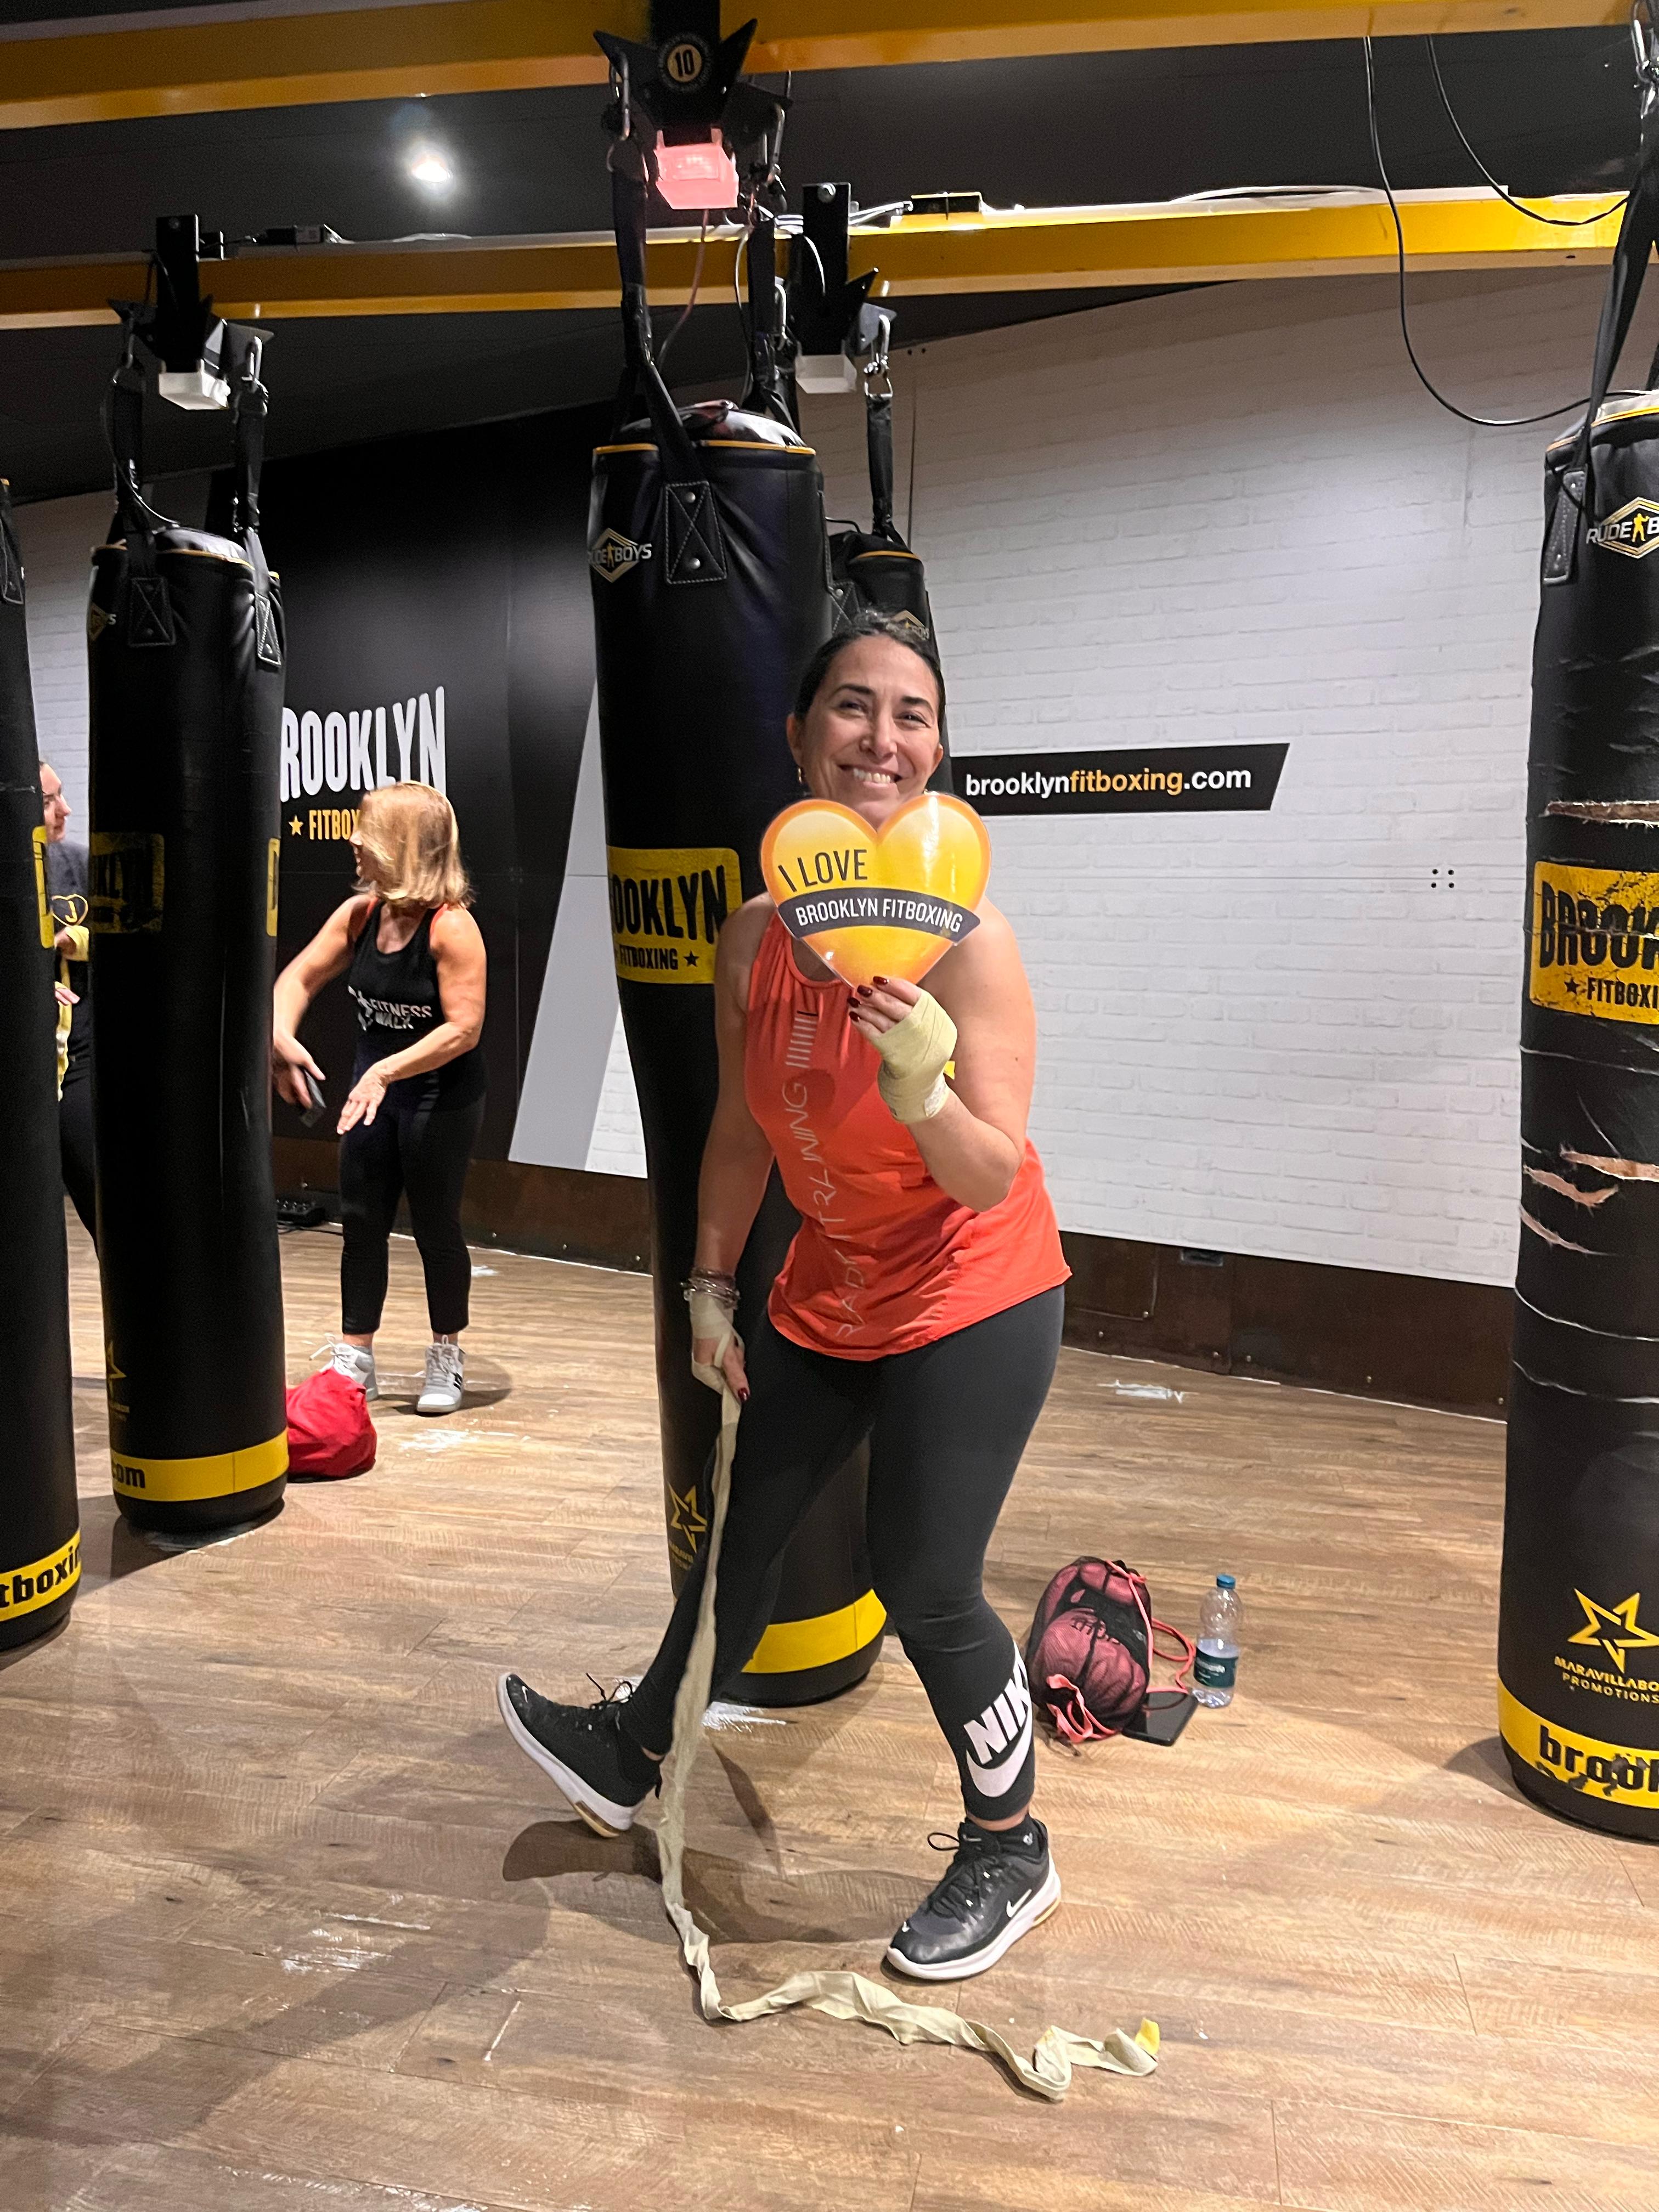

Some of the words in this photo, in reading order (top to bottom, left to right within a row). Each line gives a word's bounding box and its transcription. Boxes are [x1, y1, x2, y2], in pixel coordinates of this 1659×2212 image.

[675, 49, 695, 77] 10
[1585, 521, 1633, 544] RUDE
[614, 543, 652, 562] BOYS
[966, 768, 1251, 798] brooklynfitboxing.com
[778, 864, 797, 893] I
[797, 849, 868, 888] LOVE
[795, 898, 878, 926] BROOKLYN
[882, 898, 963, 933] FITBOXING
[369, 998, 432, 1018] FITNESS
